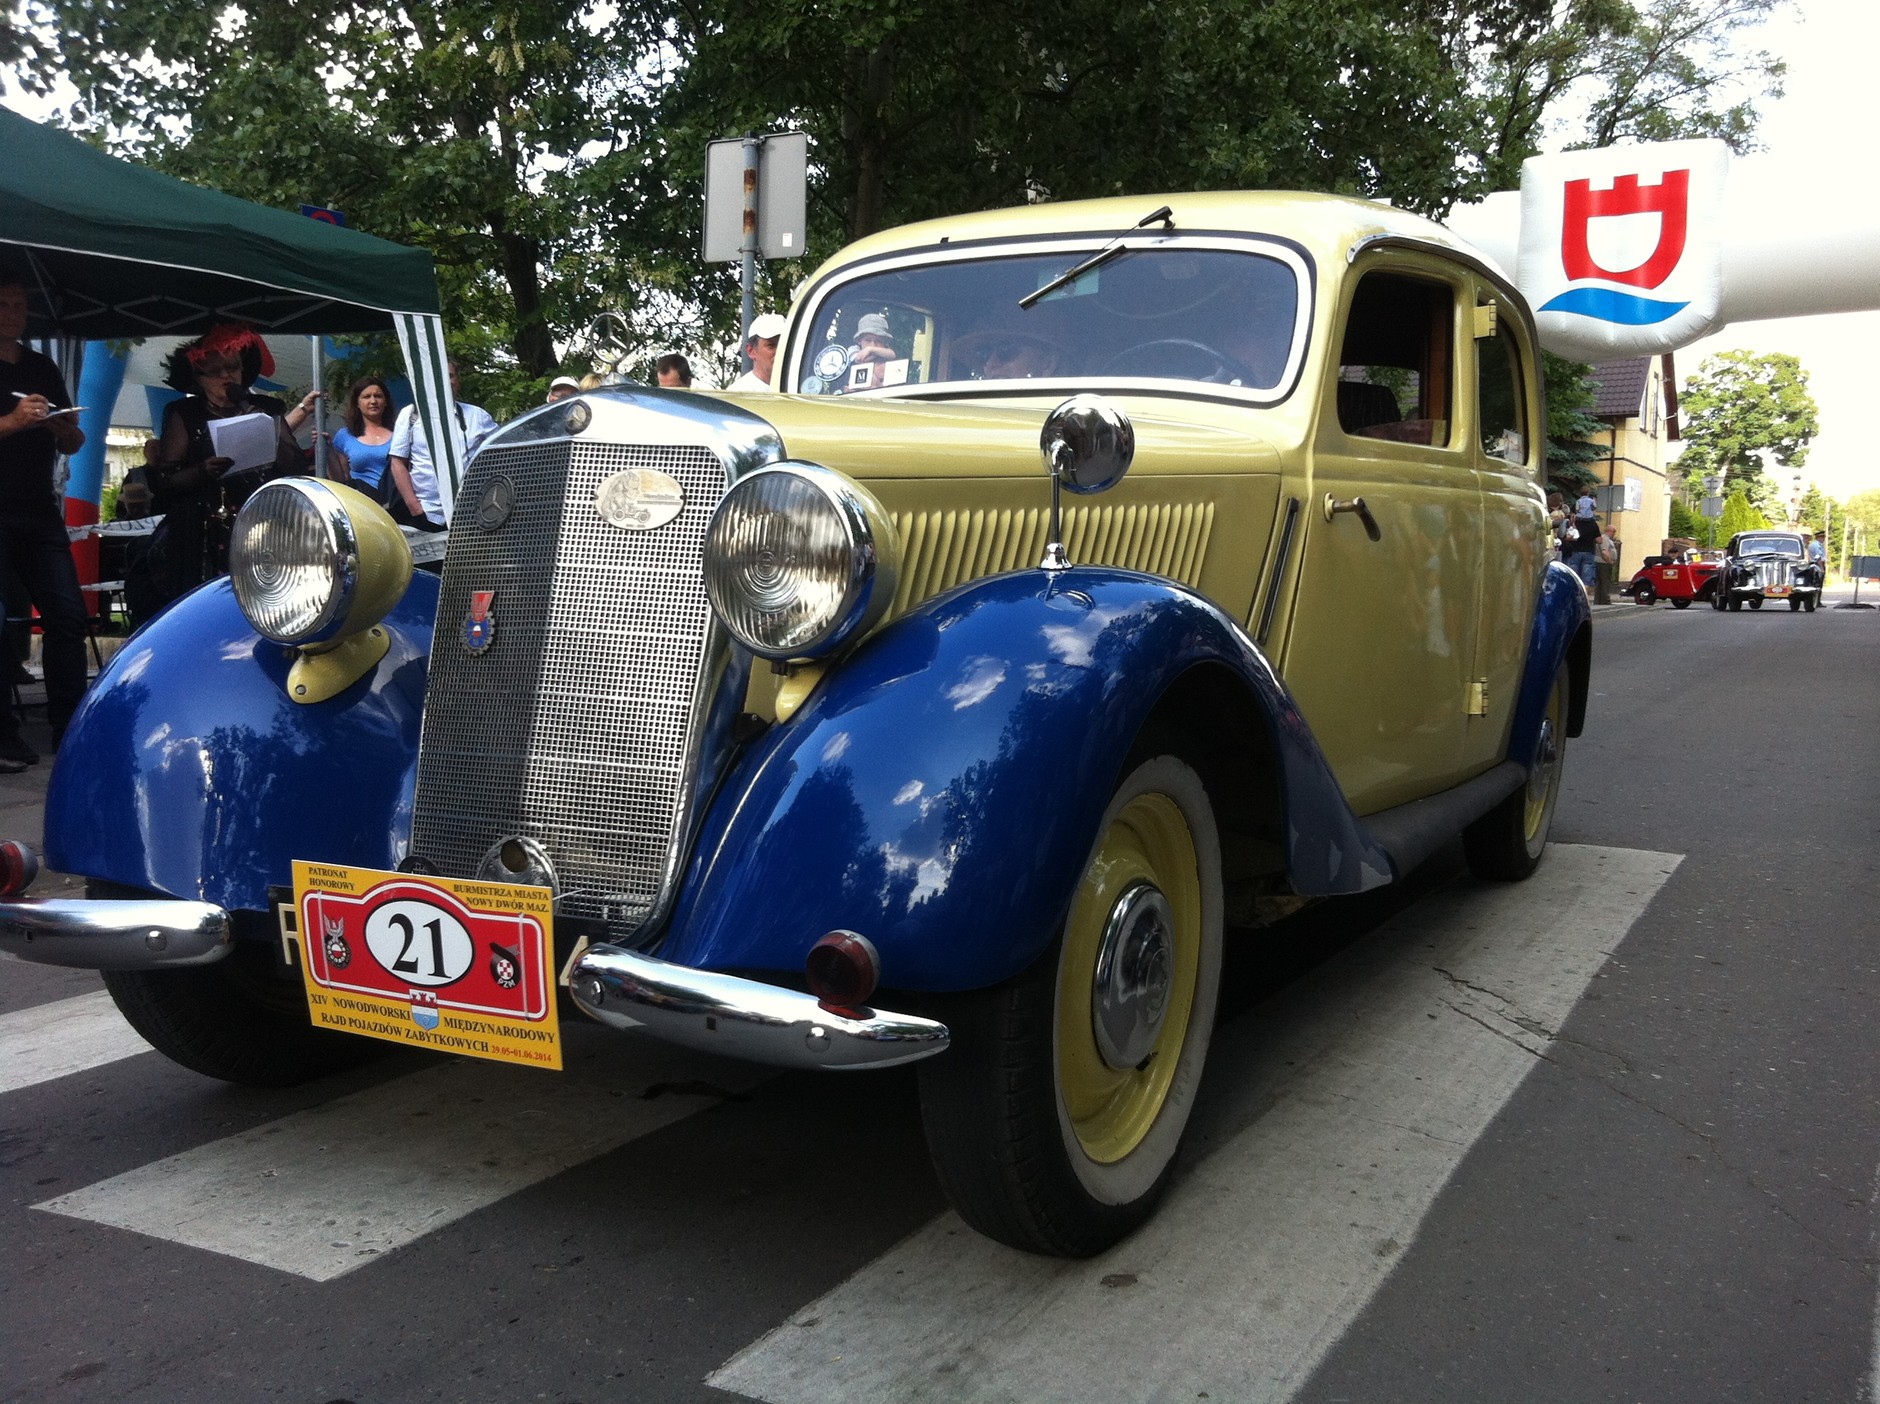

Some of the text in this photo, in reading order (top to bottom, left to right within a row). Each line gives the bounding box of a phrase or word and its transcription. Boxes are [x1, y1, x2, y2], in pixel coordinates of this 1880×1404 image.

[308, 866, 348, 879] PATRONAT
[309, 877, 355, 891] HONOROWY
[453, 884, 549, 901] BURMISTRZA MIASTA
[466, 896, 550, 912] NOWY DWÓR MAZ.
[388, 913, 453, 979] 21
[497, 978, 516, 988] PZM
[310, 993, 556, 1044] XIV NOWODWORSKI MIĘDZYNARODOWY
[321, 1012, 347, 1026] RAJD
[349, 1017, 403, 1037] POJAZDÓW
[405, 1029, 489, 1053] ZABYTKOWYCH
